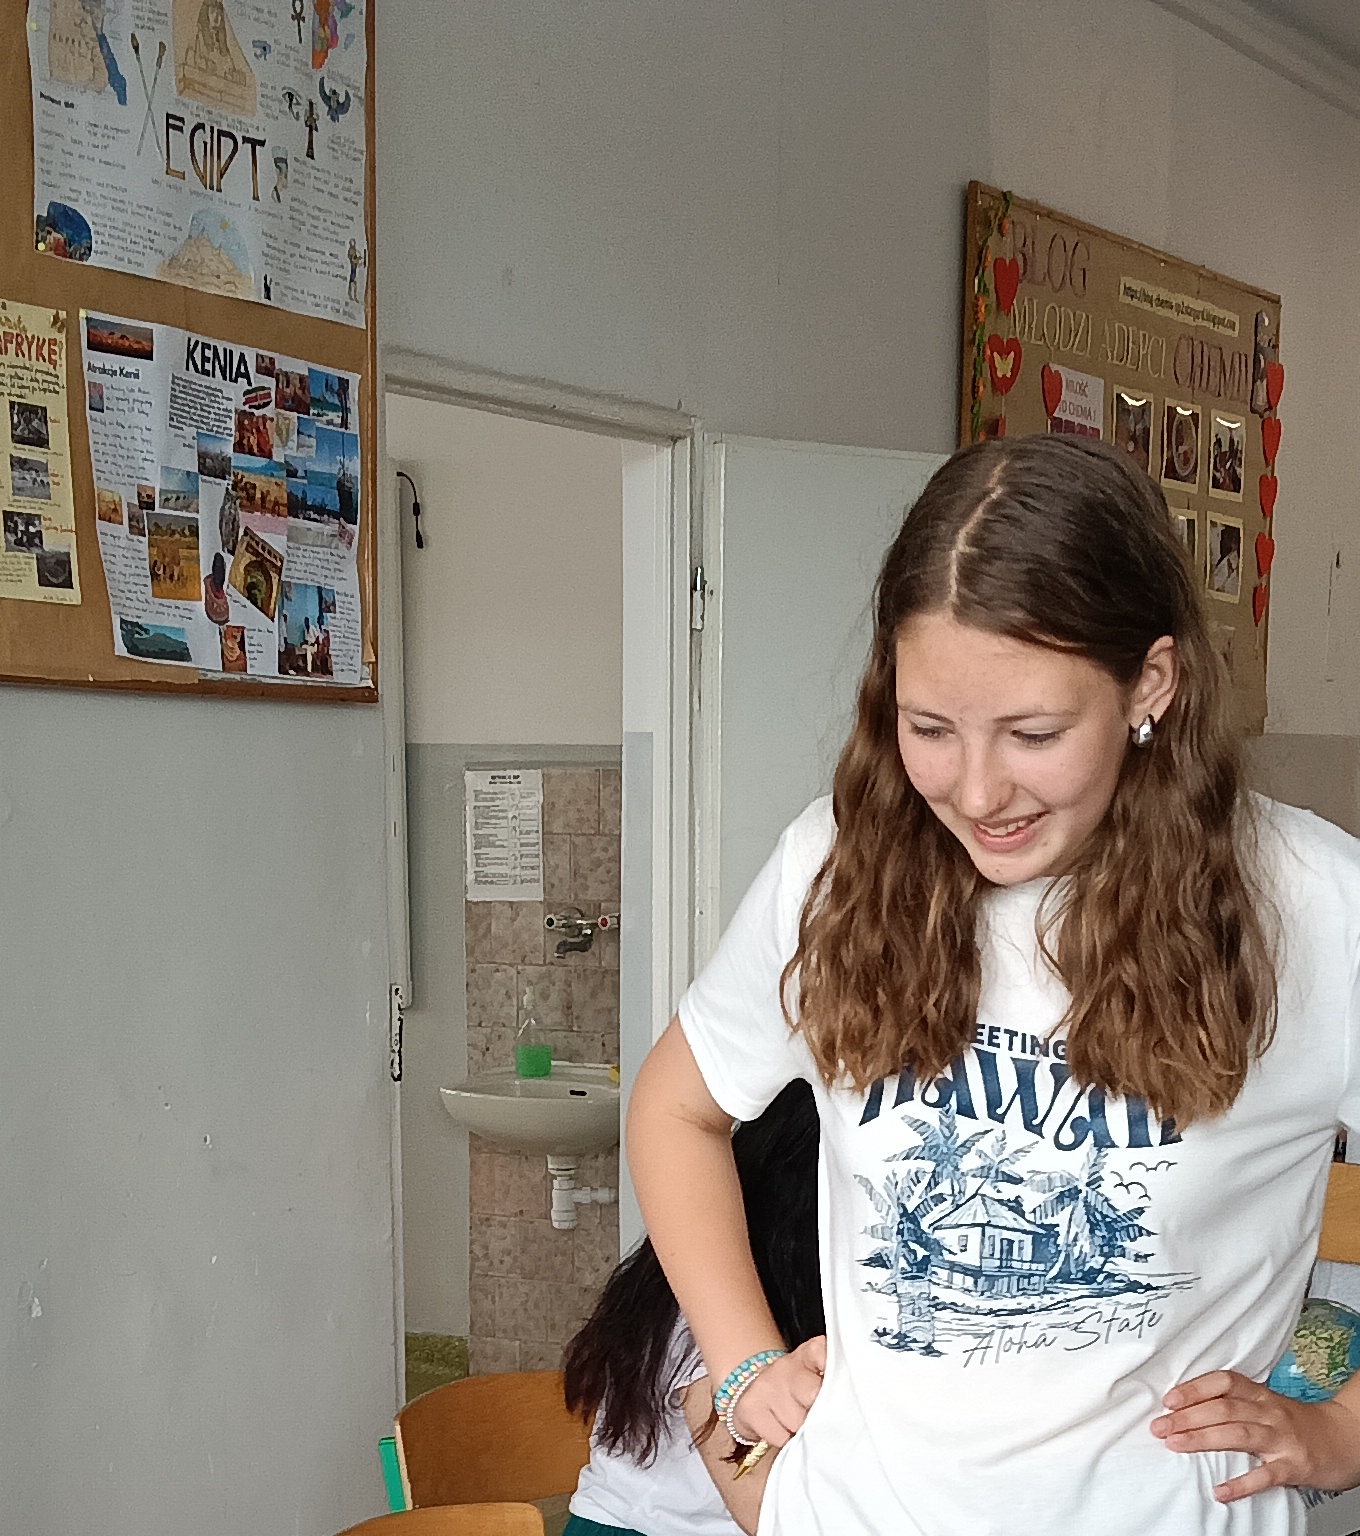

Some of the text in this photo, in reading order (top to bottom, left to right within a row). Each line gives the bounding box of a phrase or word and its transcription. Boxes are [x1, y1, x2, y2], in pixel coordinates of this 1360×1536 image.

[166, 112, 267, 202] EGIPT
[1011, 221, 1090, 298] BLOG
[185, 337, 252, 387] KENIA
[974, 1022, 1067, 1060] EETING
[963, 1302, 1164, 1368] Aloha State
